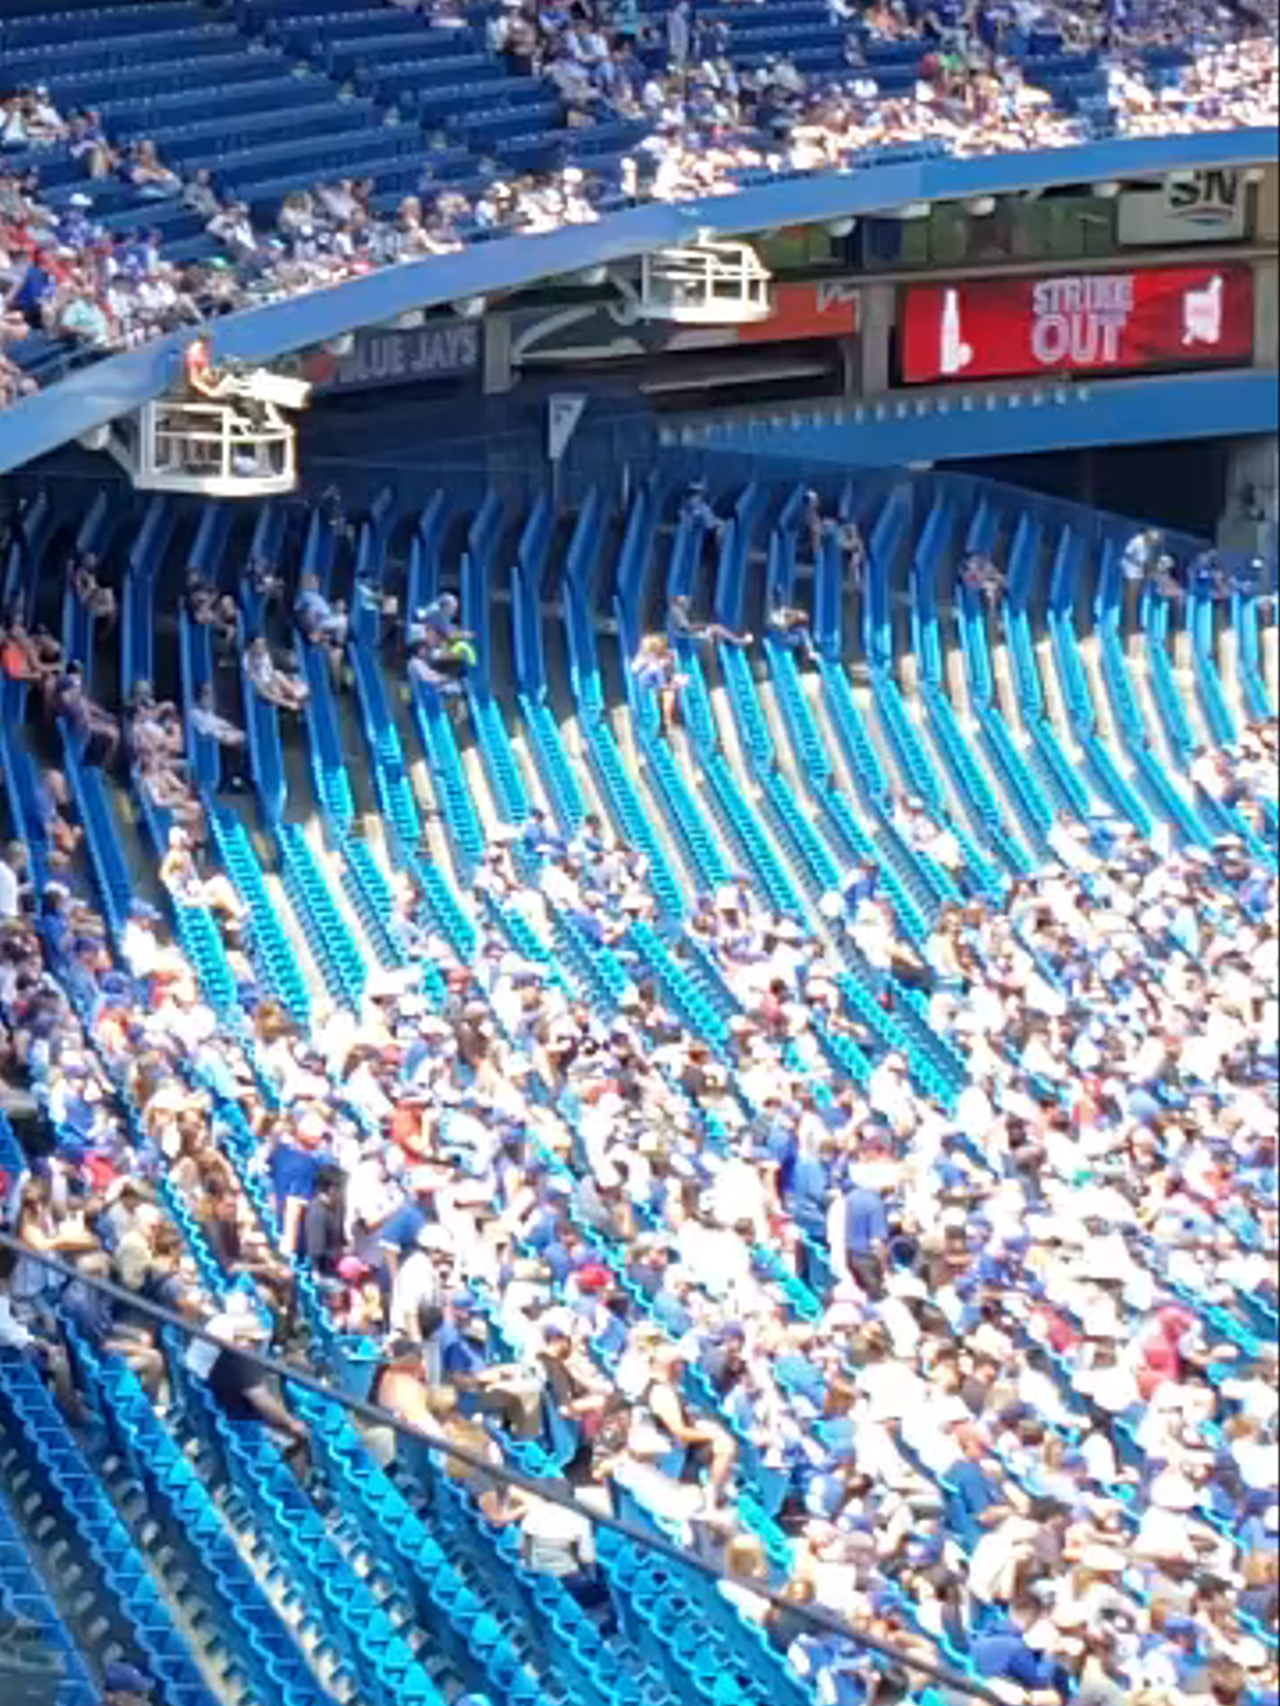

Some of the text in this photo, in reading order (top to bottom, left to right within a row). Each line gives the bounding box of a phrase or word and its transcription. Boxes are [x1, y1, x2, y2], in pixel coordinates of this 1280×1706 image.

[340, 329, 478, 383] LUE JAYS
[1031, 310, 1126, 372] OUT
